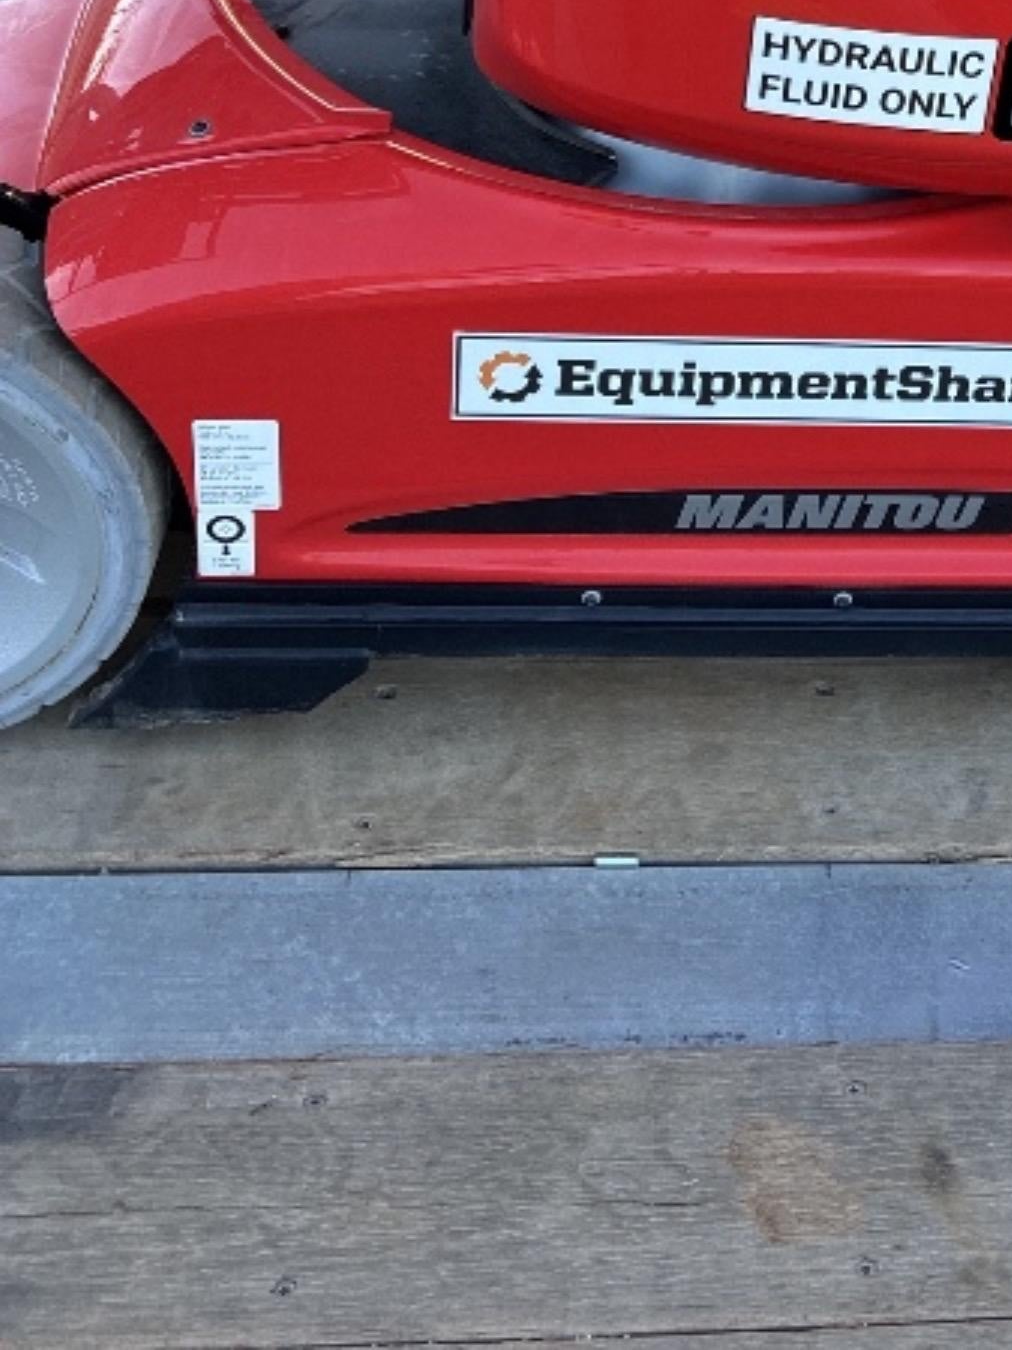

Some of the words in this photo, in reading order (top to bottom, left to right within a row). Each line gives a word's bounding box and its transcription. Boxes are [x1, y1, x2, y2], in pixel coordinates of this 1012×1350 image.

[761, 31, 986, 79] HYDRAULIC
[758, 73, 868, 111] FLUID
[879, 88, 978, 121] ONLY
[675, 493, 986, 530] MANITOU
